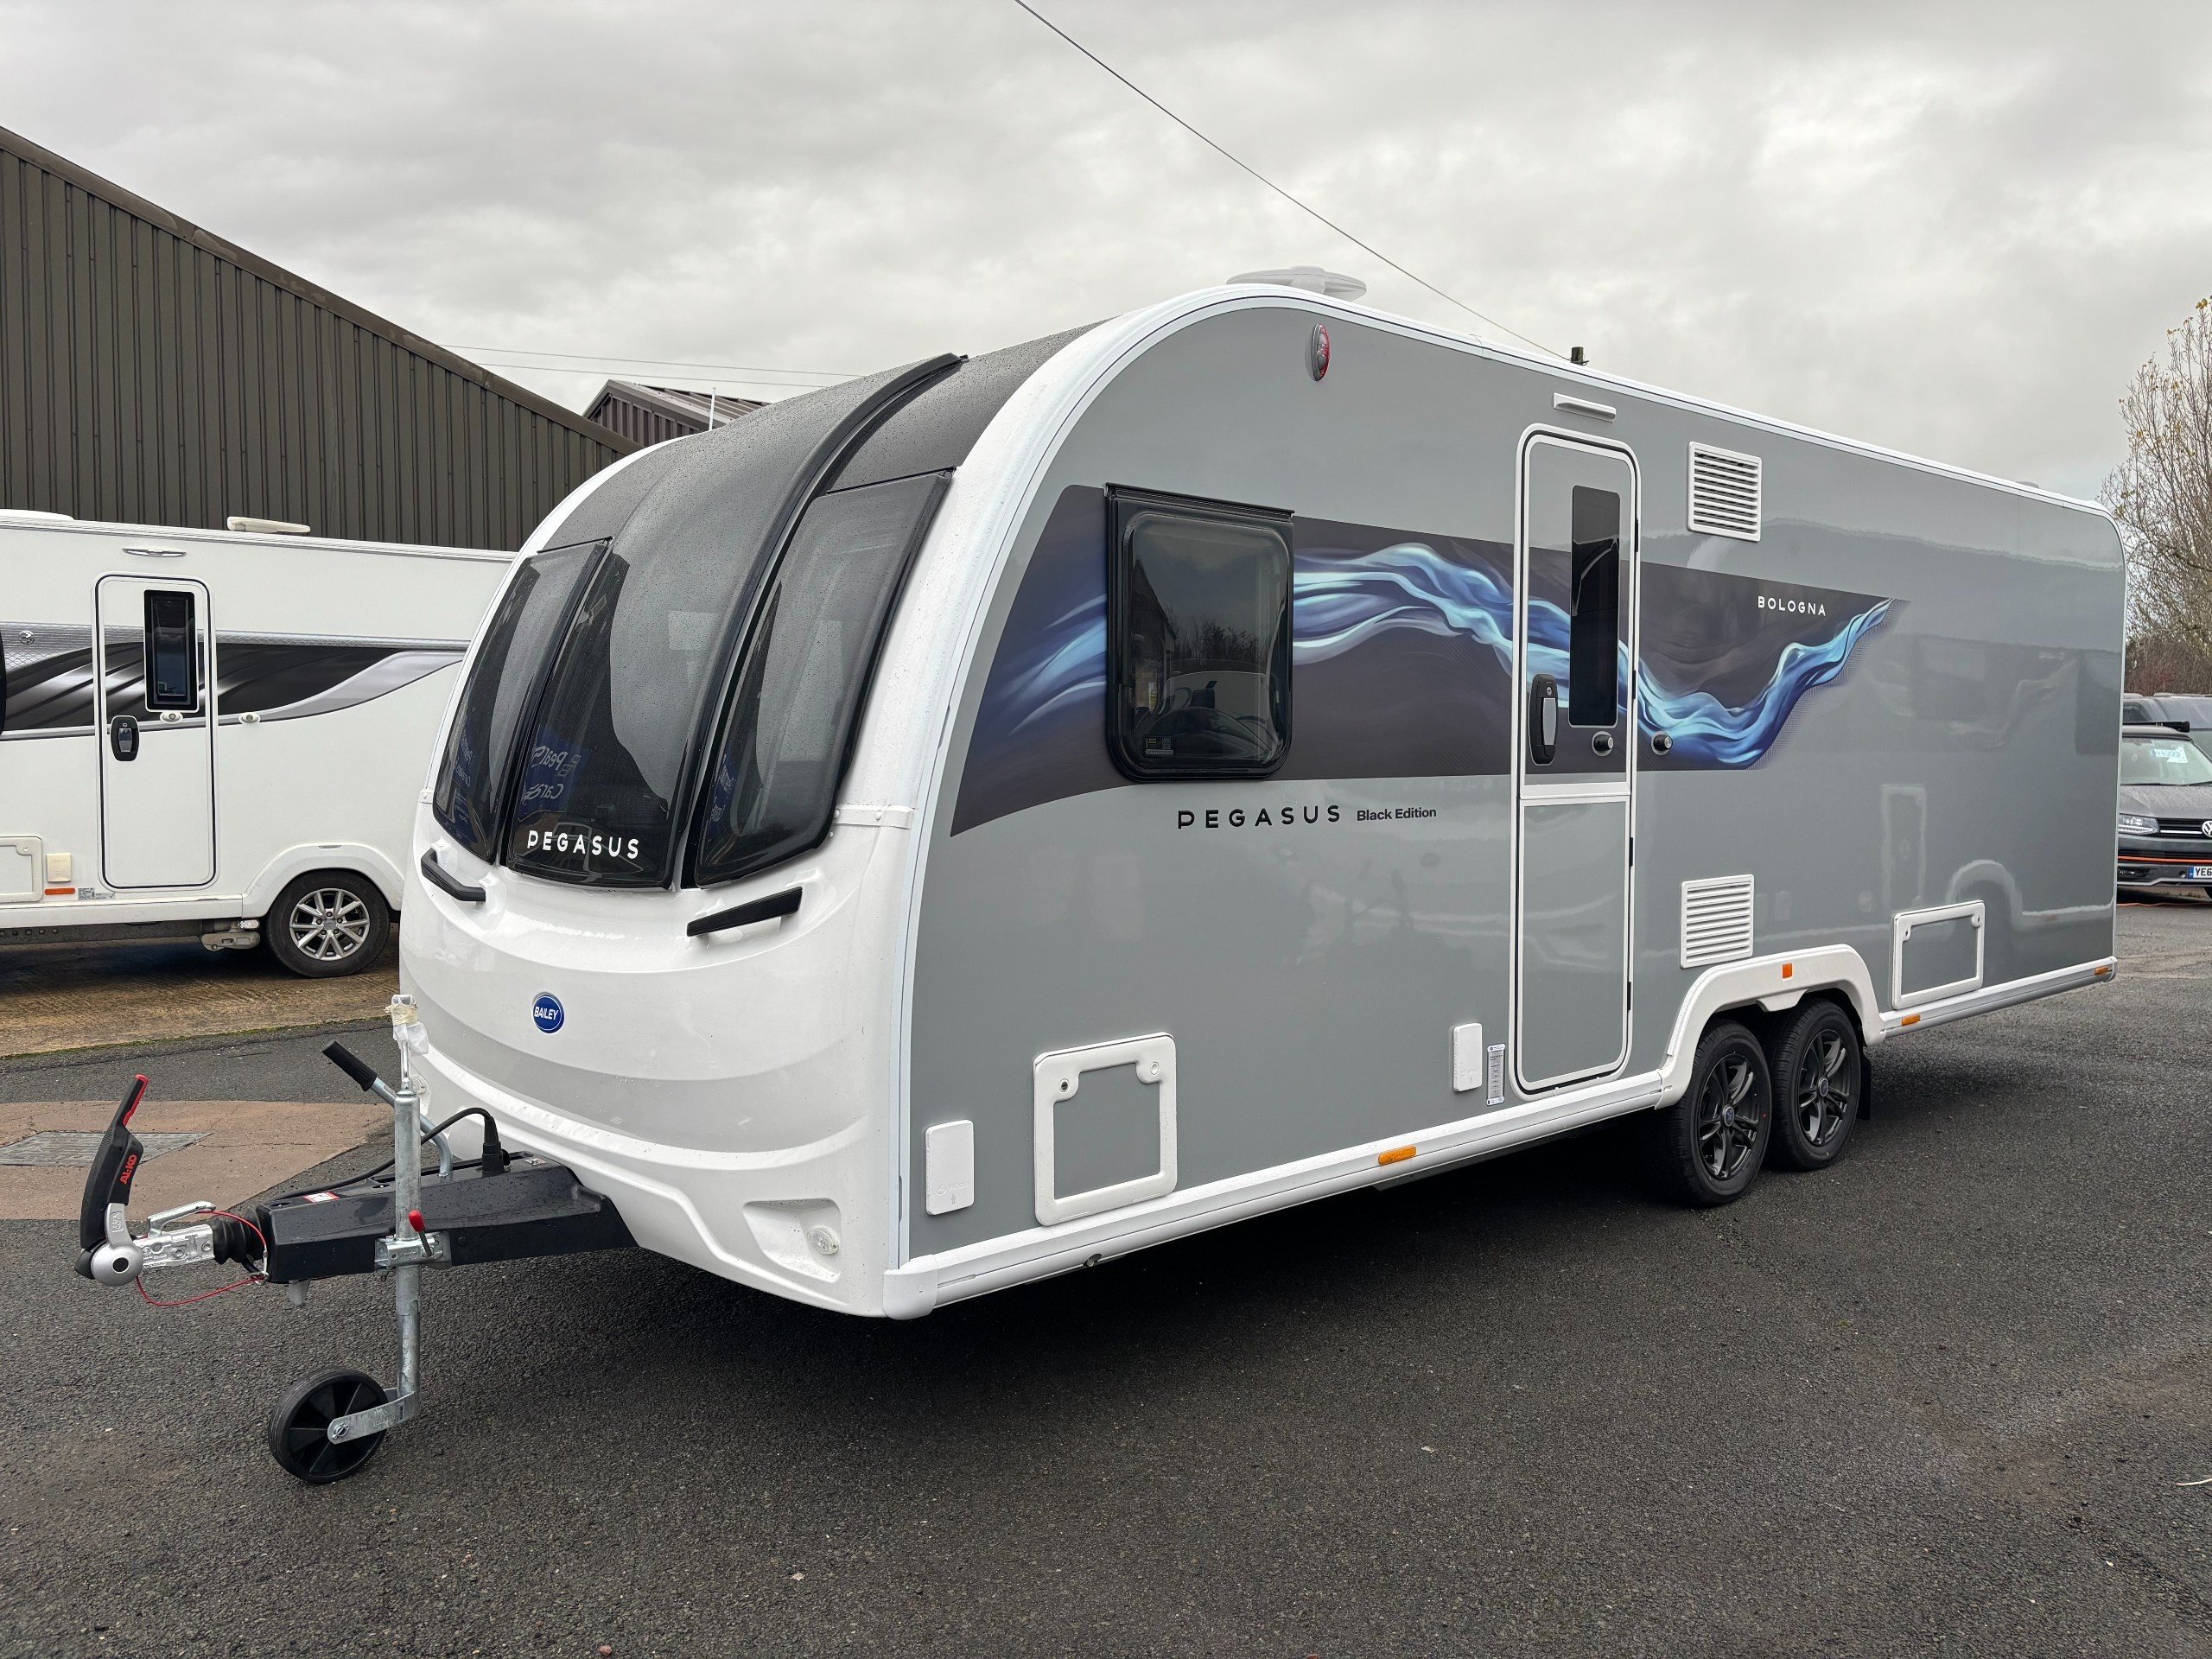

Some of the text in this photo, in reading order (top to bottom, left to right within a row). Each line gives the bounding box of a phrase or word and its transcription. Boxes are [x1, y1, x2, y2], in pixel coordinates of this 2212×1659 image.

[1758, 595, 1826, 616] BOLOGNA
[1178, 804, 1437, 830] PEGASUS Black Edition
[526, 830, 639, 860] PEGASUS
[533, 1006, 559, 1020] BAILEY
[119, 1154, 138, 1185] AL-KO
